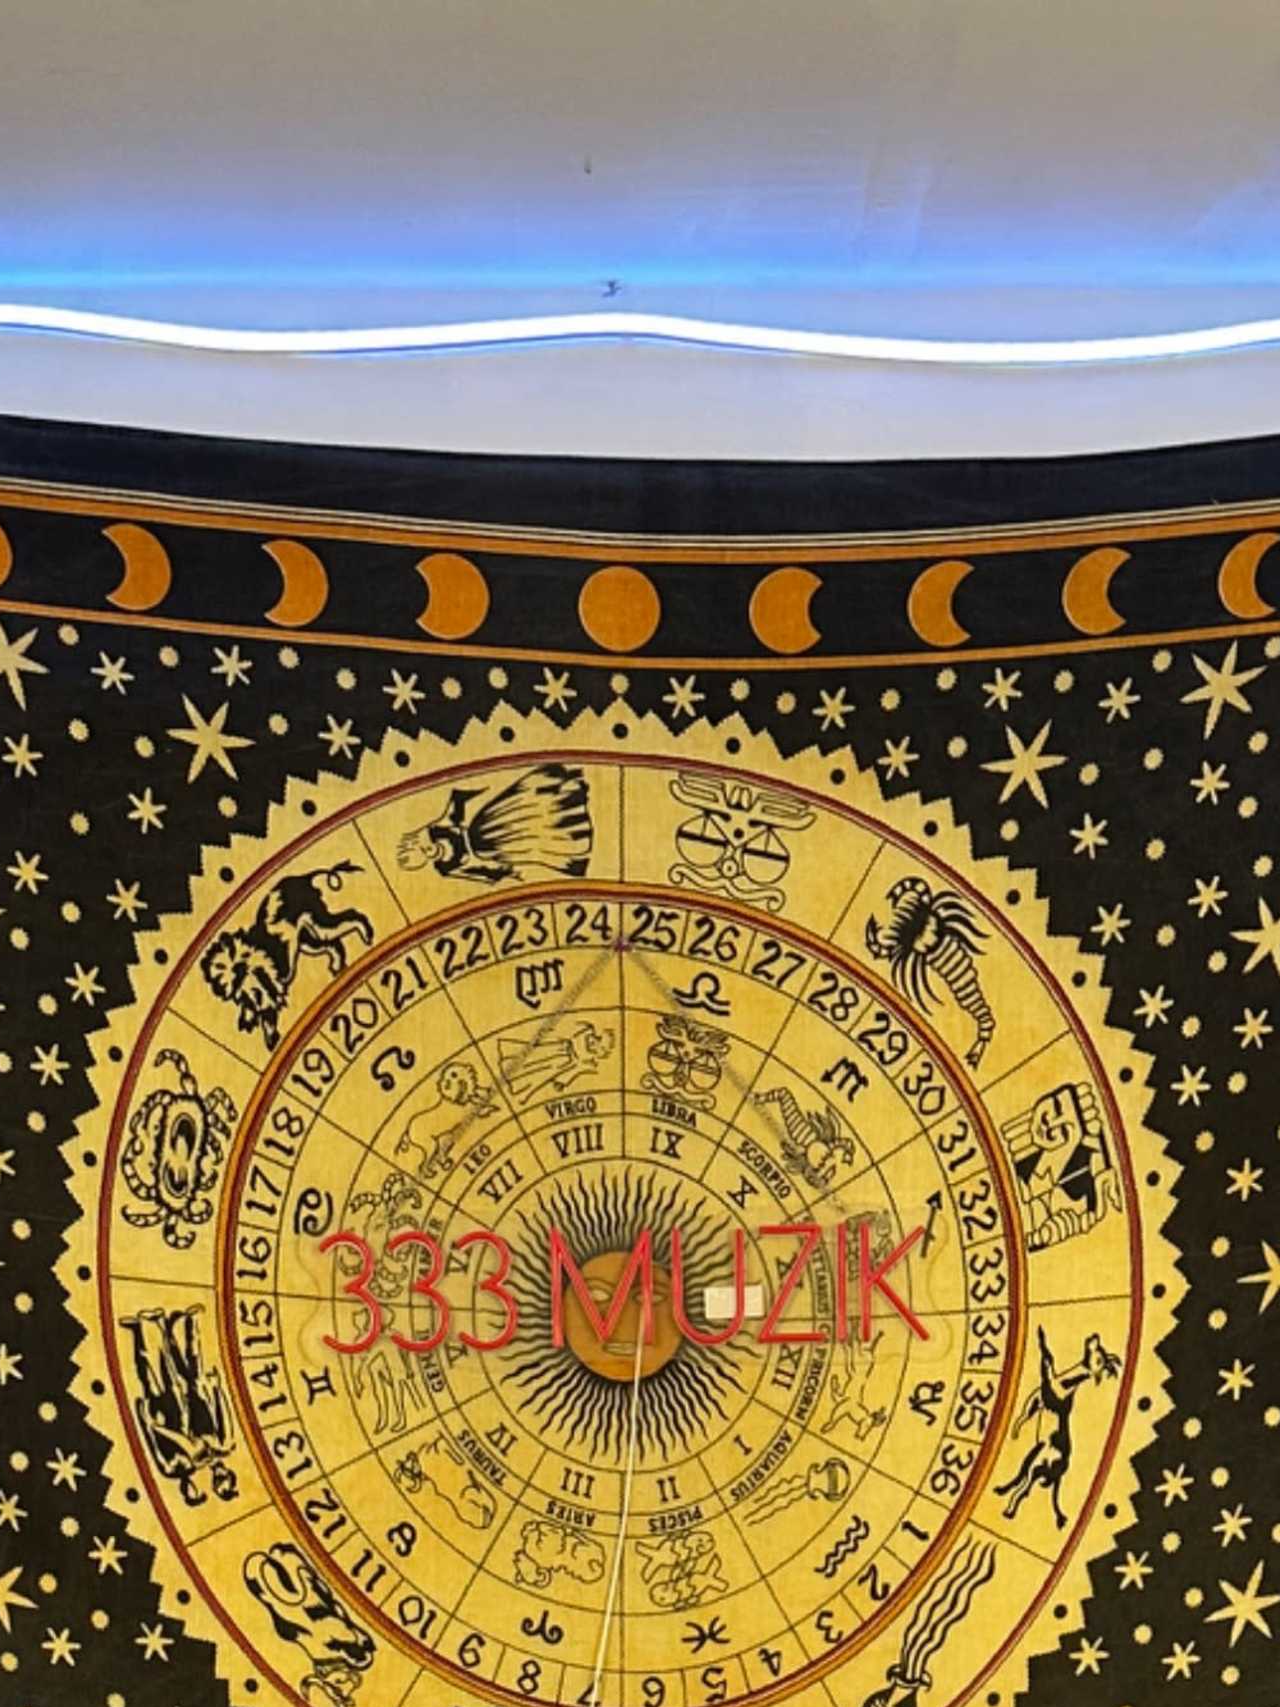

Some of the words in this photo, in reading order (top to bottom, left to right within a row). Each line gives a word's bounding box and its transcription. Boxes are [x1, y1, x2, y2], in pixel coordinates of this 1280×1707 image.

[496, 907, 548, 954] 23
[565, 903, 611, 943] 24
[631, 905, 679, 952] 25
[684, 916, 741, 963] 26
[435, 925, 488, 978] 22
[751, 939, 807, 988] 27
[380, 956, 429, 1011] 21
[807, 972, 859, 1022] 28
[330, 997, 379, 1054] 20
[858, 1013, 909, 1066] 29
[291, 1048, 334, 1098] 19
[904, 1062, 945, 1116] 30
[264, 1106, 303, 1158] 18
[545, 1096, 597, 1121] VIRGO
[650, 1100, 698, 1128] LIBRA
[461, 1144, 492, 1176] LEO
[550, 1123, 604, 1159] VIII
[650, 1129, 684, 1159] IX
[938, 1120, 976, 1172] 31
[246, 1164, 283, 1218] 17
[478, 1158, 525, 1203] VII
[728, 1176, 758, 1208] X
[735, 1139, 791, 1200] SCORPIO
[959, 1179, 997, 1240] 32
[237, 1236, 271, 1283] 16
[969, 1245, 1006, 1304] 33
[318, 1231, 517, 1354] 333
[548, 1224, 931, 1348] MUZIK
[241, 1299, 273, 1347] 15
[968, 1313, 1004, 1365] 34
[251, 1361, 287, 1413] 14
[772, 1347, 803, 1390] XII
[954, 1379, 994, 1433] 35
[273, 1430, 314, 1478] 13
[456, 1428, 507, 1487] TAURUS
[485, 1421, 518, 1457] IV
[733, 1438, 752, 1456] I
[559, 1467, 594, 1499] III
[656, 1476, 681, 1501] II
[731, 1430, 792, 1500] AQUARIUS
[930, 1443, 975, 1496] 36
[306, 1487, 346, 1540] 12
[544, 1500, 595, 1527] ARIES
[647, 1506, 705, 1533] PISCES
[900, 1520, 929, 1541] 1
[349, 1547, 387, 1593] 11
[858, 1563, 890, 1600] 2
[398, 1595, 438, 1640] 10
[815, 1610, 844, 1645] 3
[456, 1632, 488, 1669] 9
[759, 1647, 785, 1676] 4
[516, 1659, 541, 1695] 8
[576, 1674, 602, 1707] 7
[701, 1667, 729, 1704] 5
